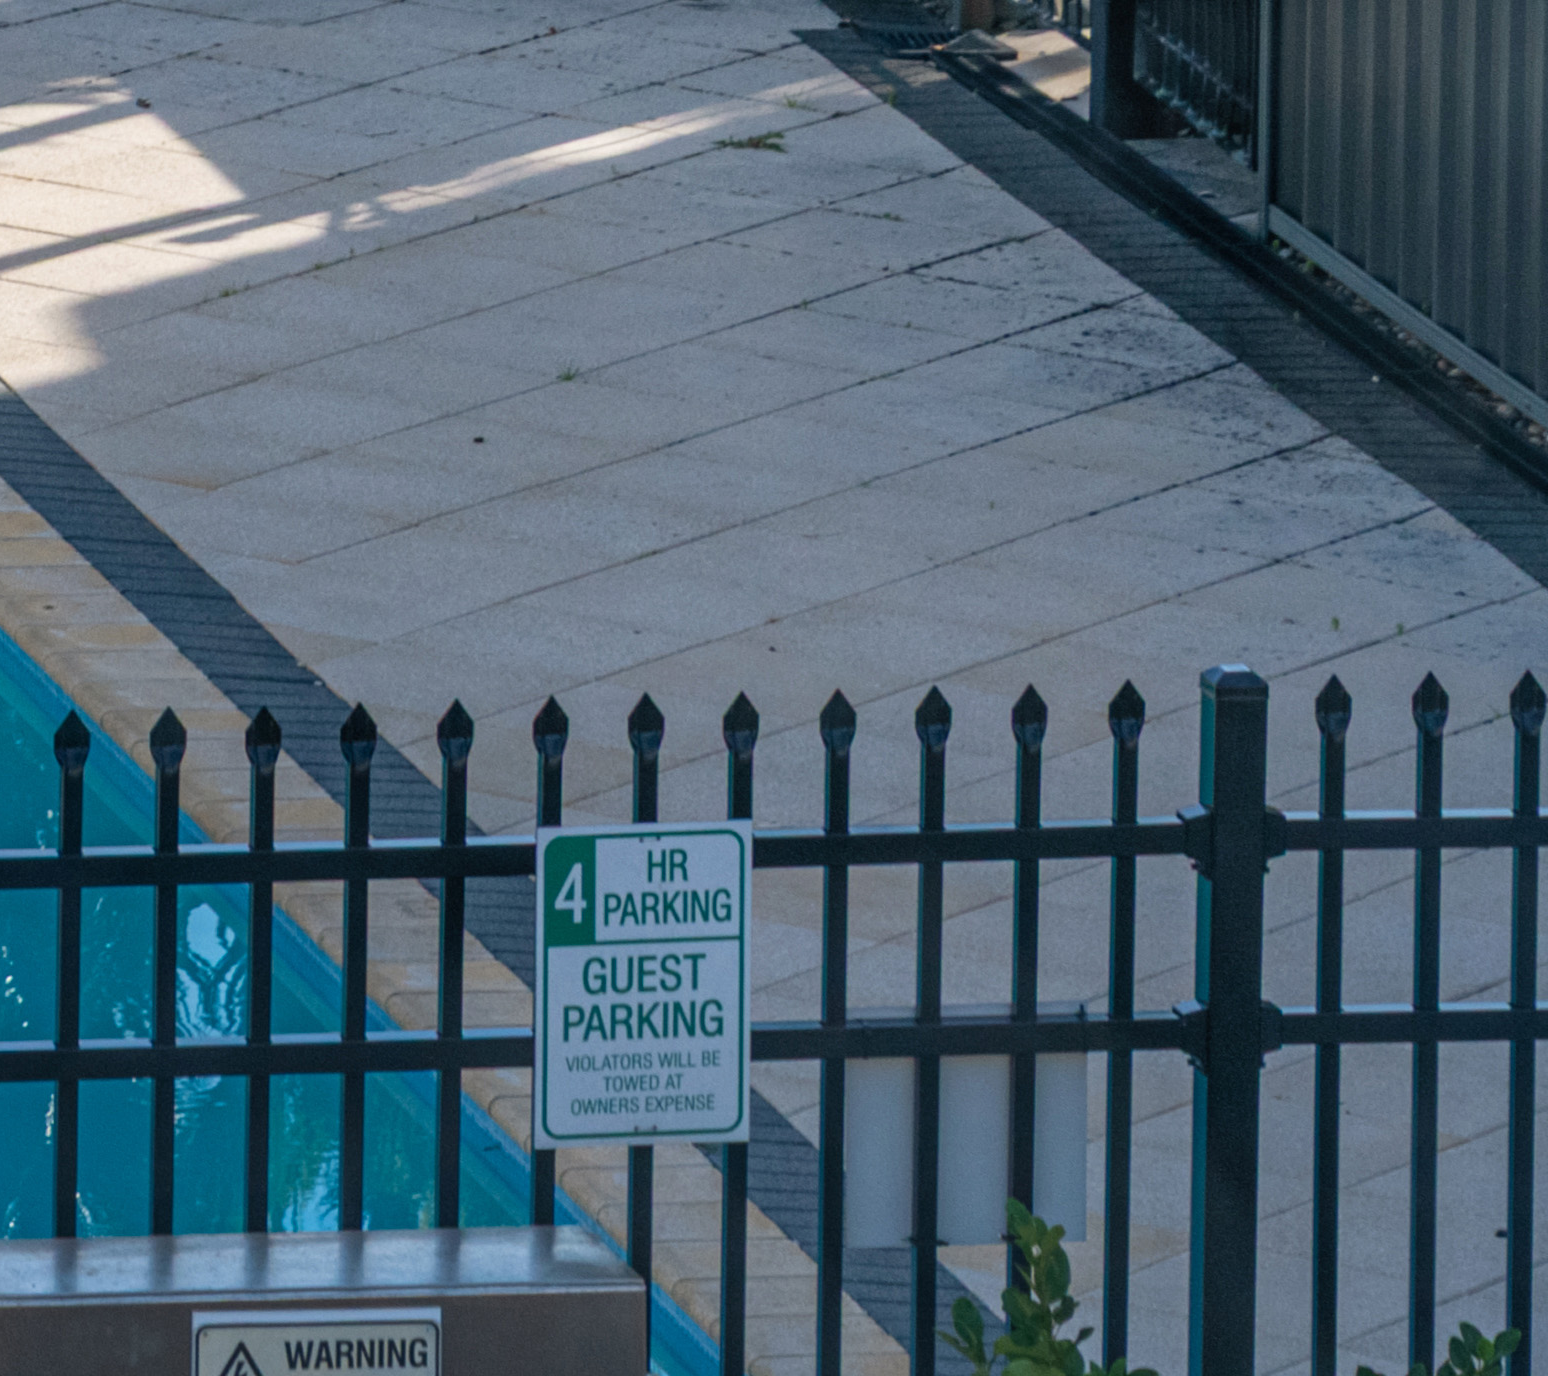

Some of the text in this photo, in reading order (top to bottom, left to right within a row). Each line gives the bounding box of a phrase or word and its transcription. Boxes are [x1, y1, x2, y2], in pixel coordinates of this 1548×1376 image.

[647, 848, 688, 883] HR
[554, 862, 587, 923] 4
[604, 888, 731, 926] PARKING
[582, 953, 706, 995] GUEST
[563, 999, 723, 1042] PARKING
[565, 1050, 720, 1072] VIOLATORS WILL BE
[604, 1072, 683, 1092] TOWED AT
[571, 1094, 714, 1115] OWNERS EXPENSE
[284, 1337, 427, 1370] WARNING
